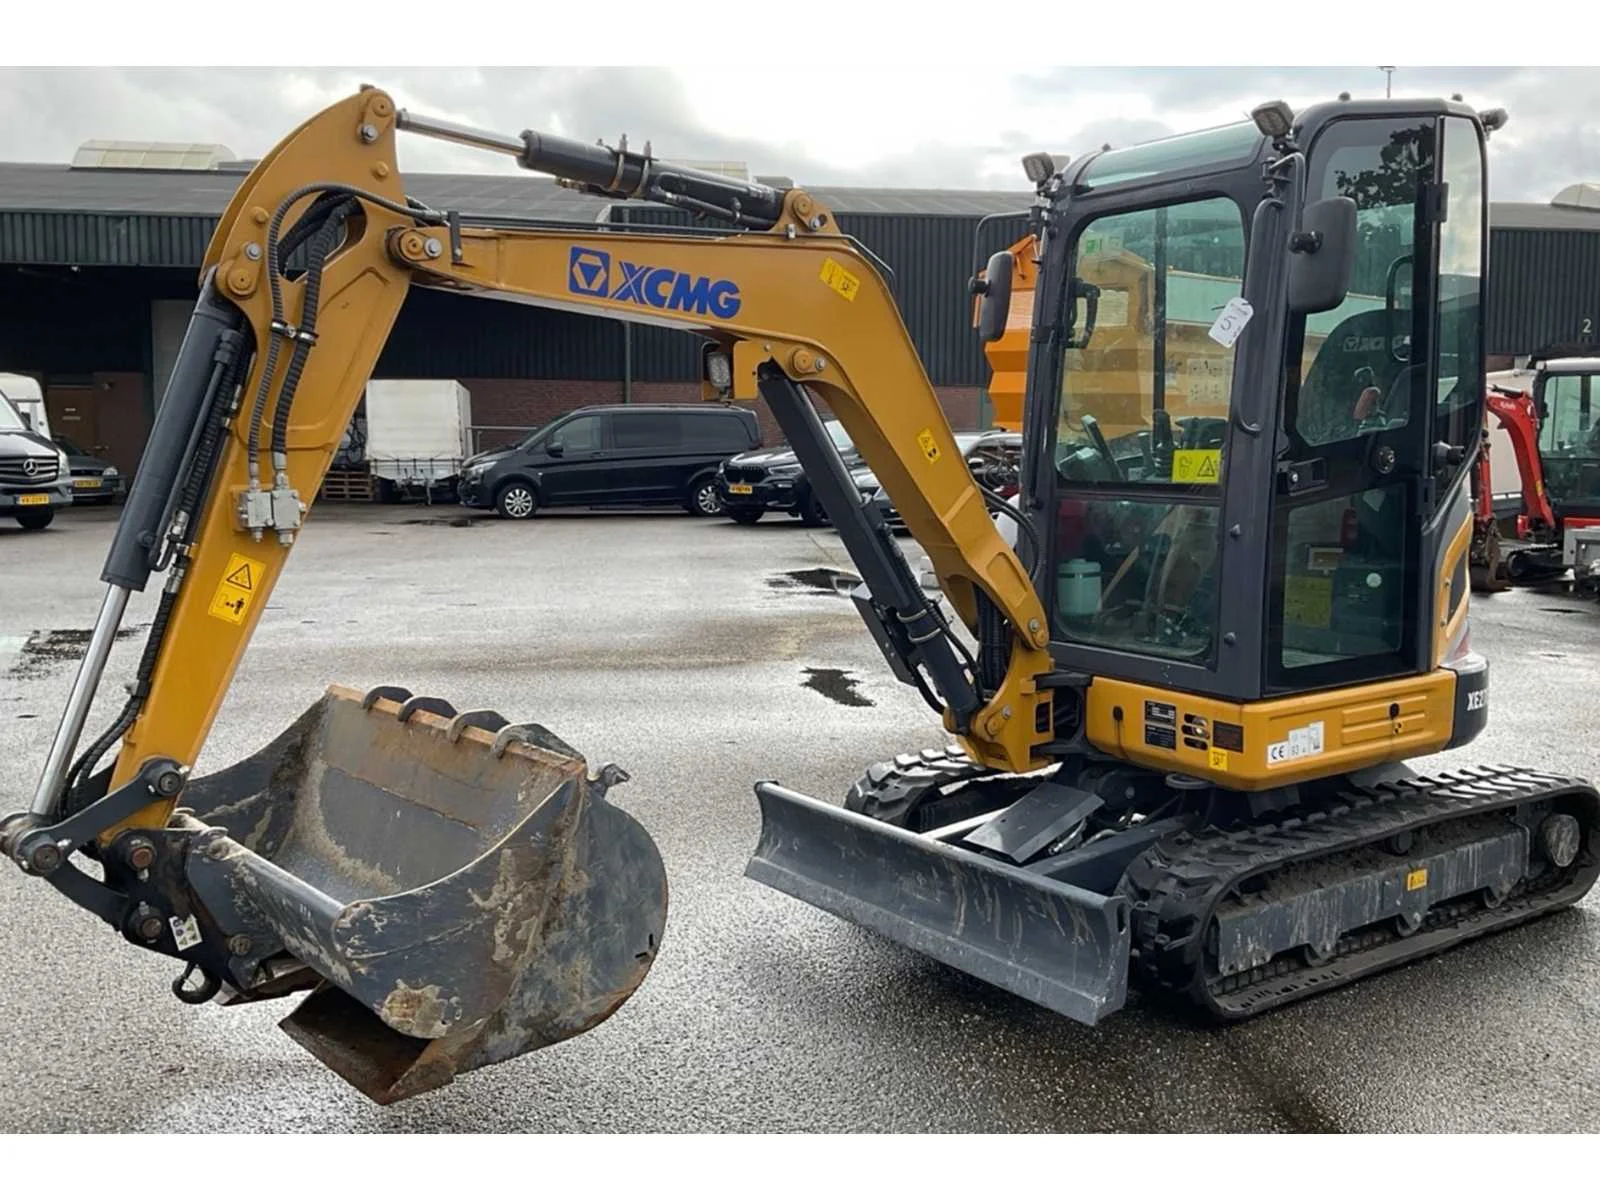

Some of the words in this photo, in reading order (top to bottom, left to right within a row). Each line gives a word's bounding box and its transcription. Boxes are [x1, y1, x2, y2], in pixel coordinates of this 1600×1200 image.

[610, 260, 741, 319] XCMG
[1582, 318, 1592, 333] 2
[1271, 745, 1285, 760] CE
